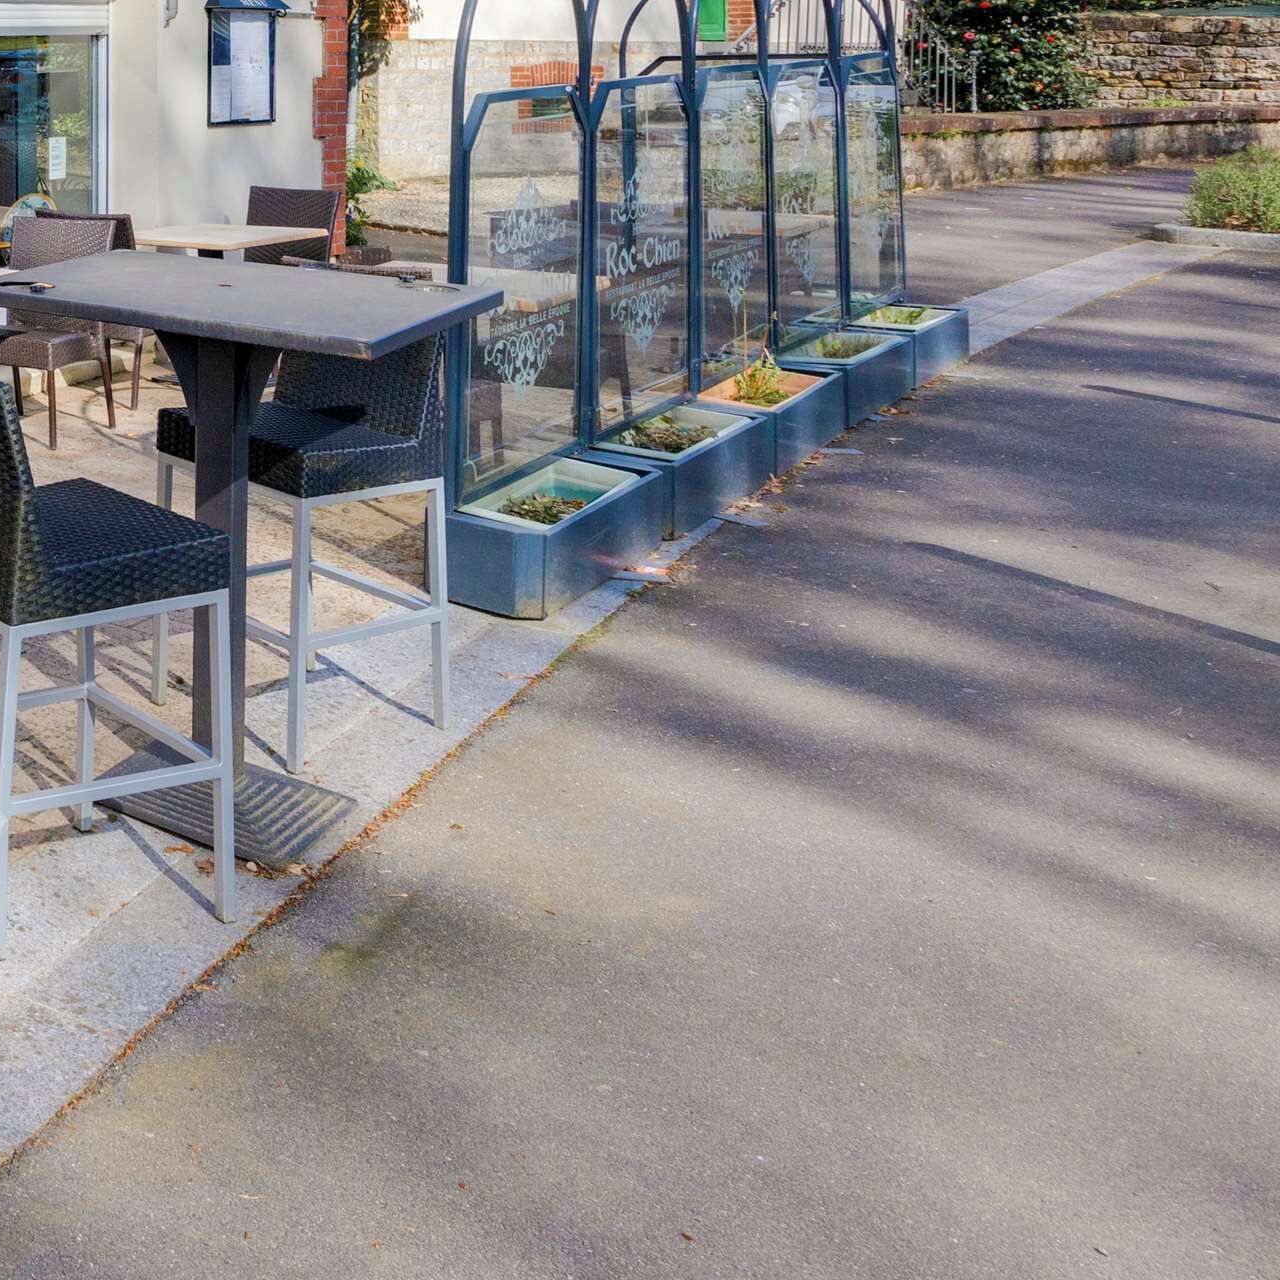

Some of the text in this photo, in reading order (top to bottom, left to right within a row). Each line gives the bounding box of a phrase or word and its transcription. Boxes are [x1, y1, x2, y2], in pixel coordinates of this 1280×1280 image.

[239, 0, 269, 8] MENU
[606, 241, 638, 279] Roc
[643, 235, 681, 269] Chien
[528, 310, 548, 326] BELLE
